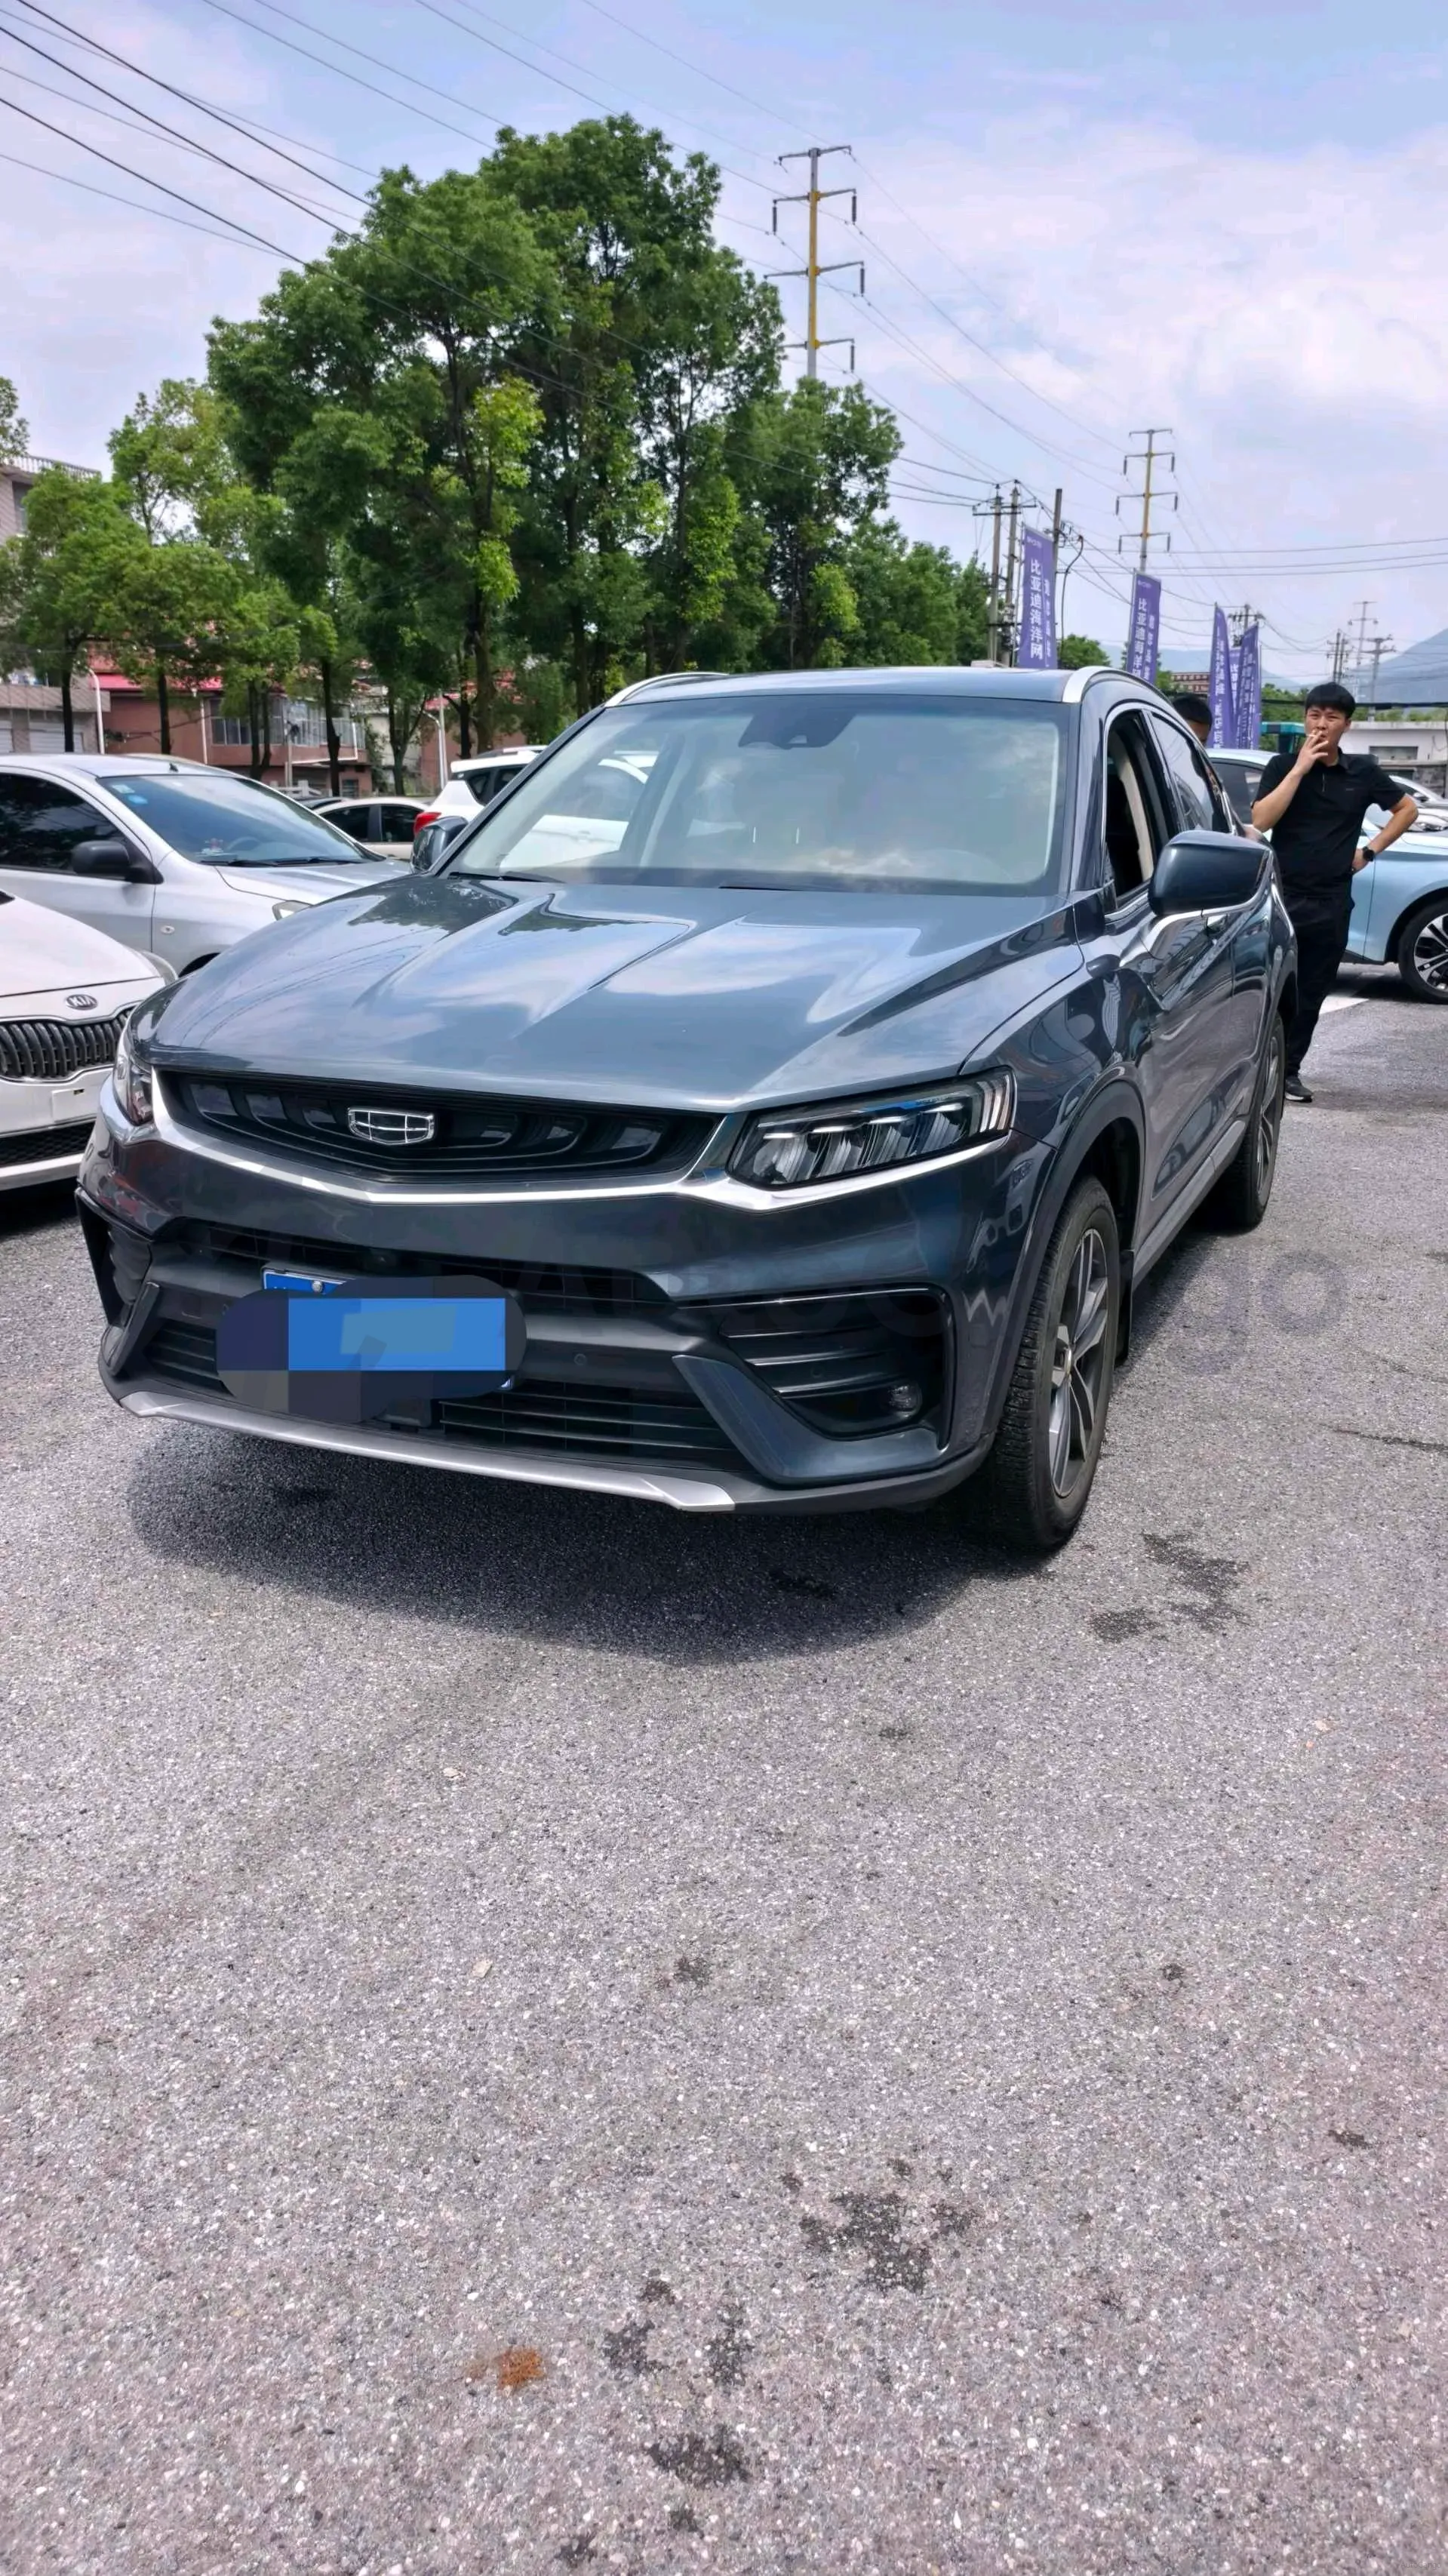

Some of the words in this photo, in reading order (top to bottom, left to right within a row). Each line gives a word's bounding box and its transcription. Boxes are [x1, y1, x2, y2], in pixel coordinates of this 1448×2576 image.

[1030, 558, 1044, 660] 比亚迪海洋网
[68, 996, 97, 1008] KIA
